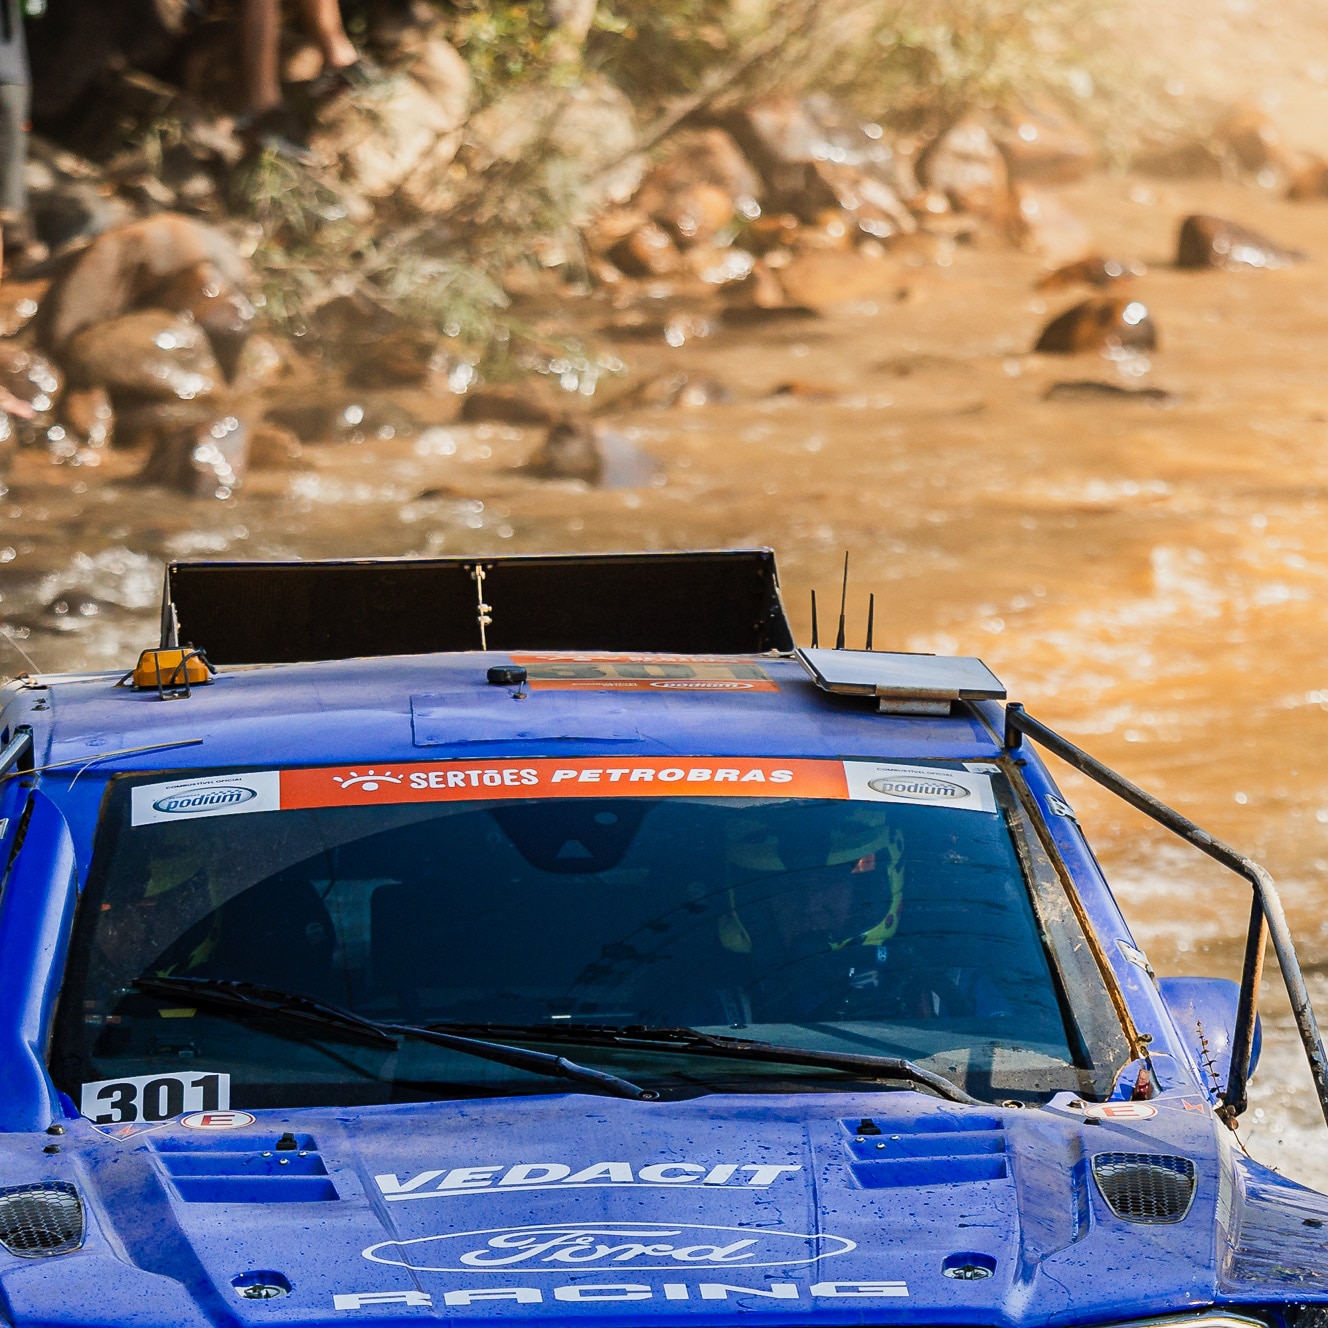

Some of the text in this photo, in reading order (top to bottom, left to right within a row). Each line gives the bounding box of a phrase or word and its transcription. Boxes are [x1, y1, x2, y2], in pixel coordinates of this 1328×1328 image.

[550, 768, 794, 783] PETROBRAS
[881, 781, 957, 797] podium
[165, 792, 243, 812] podium
[96, 1074, 220, 1125] 301
[373, 1161, 803, 1193] VEDACIT
[459, 1229, 758, 1268] Ford
[332, 1280, 910, 1311] RACING
